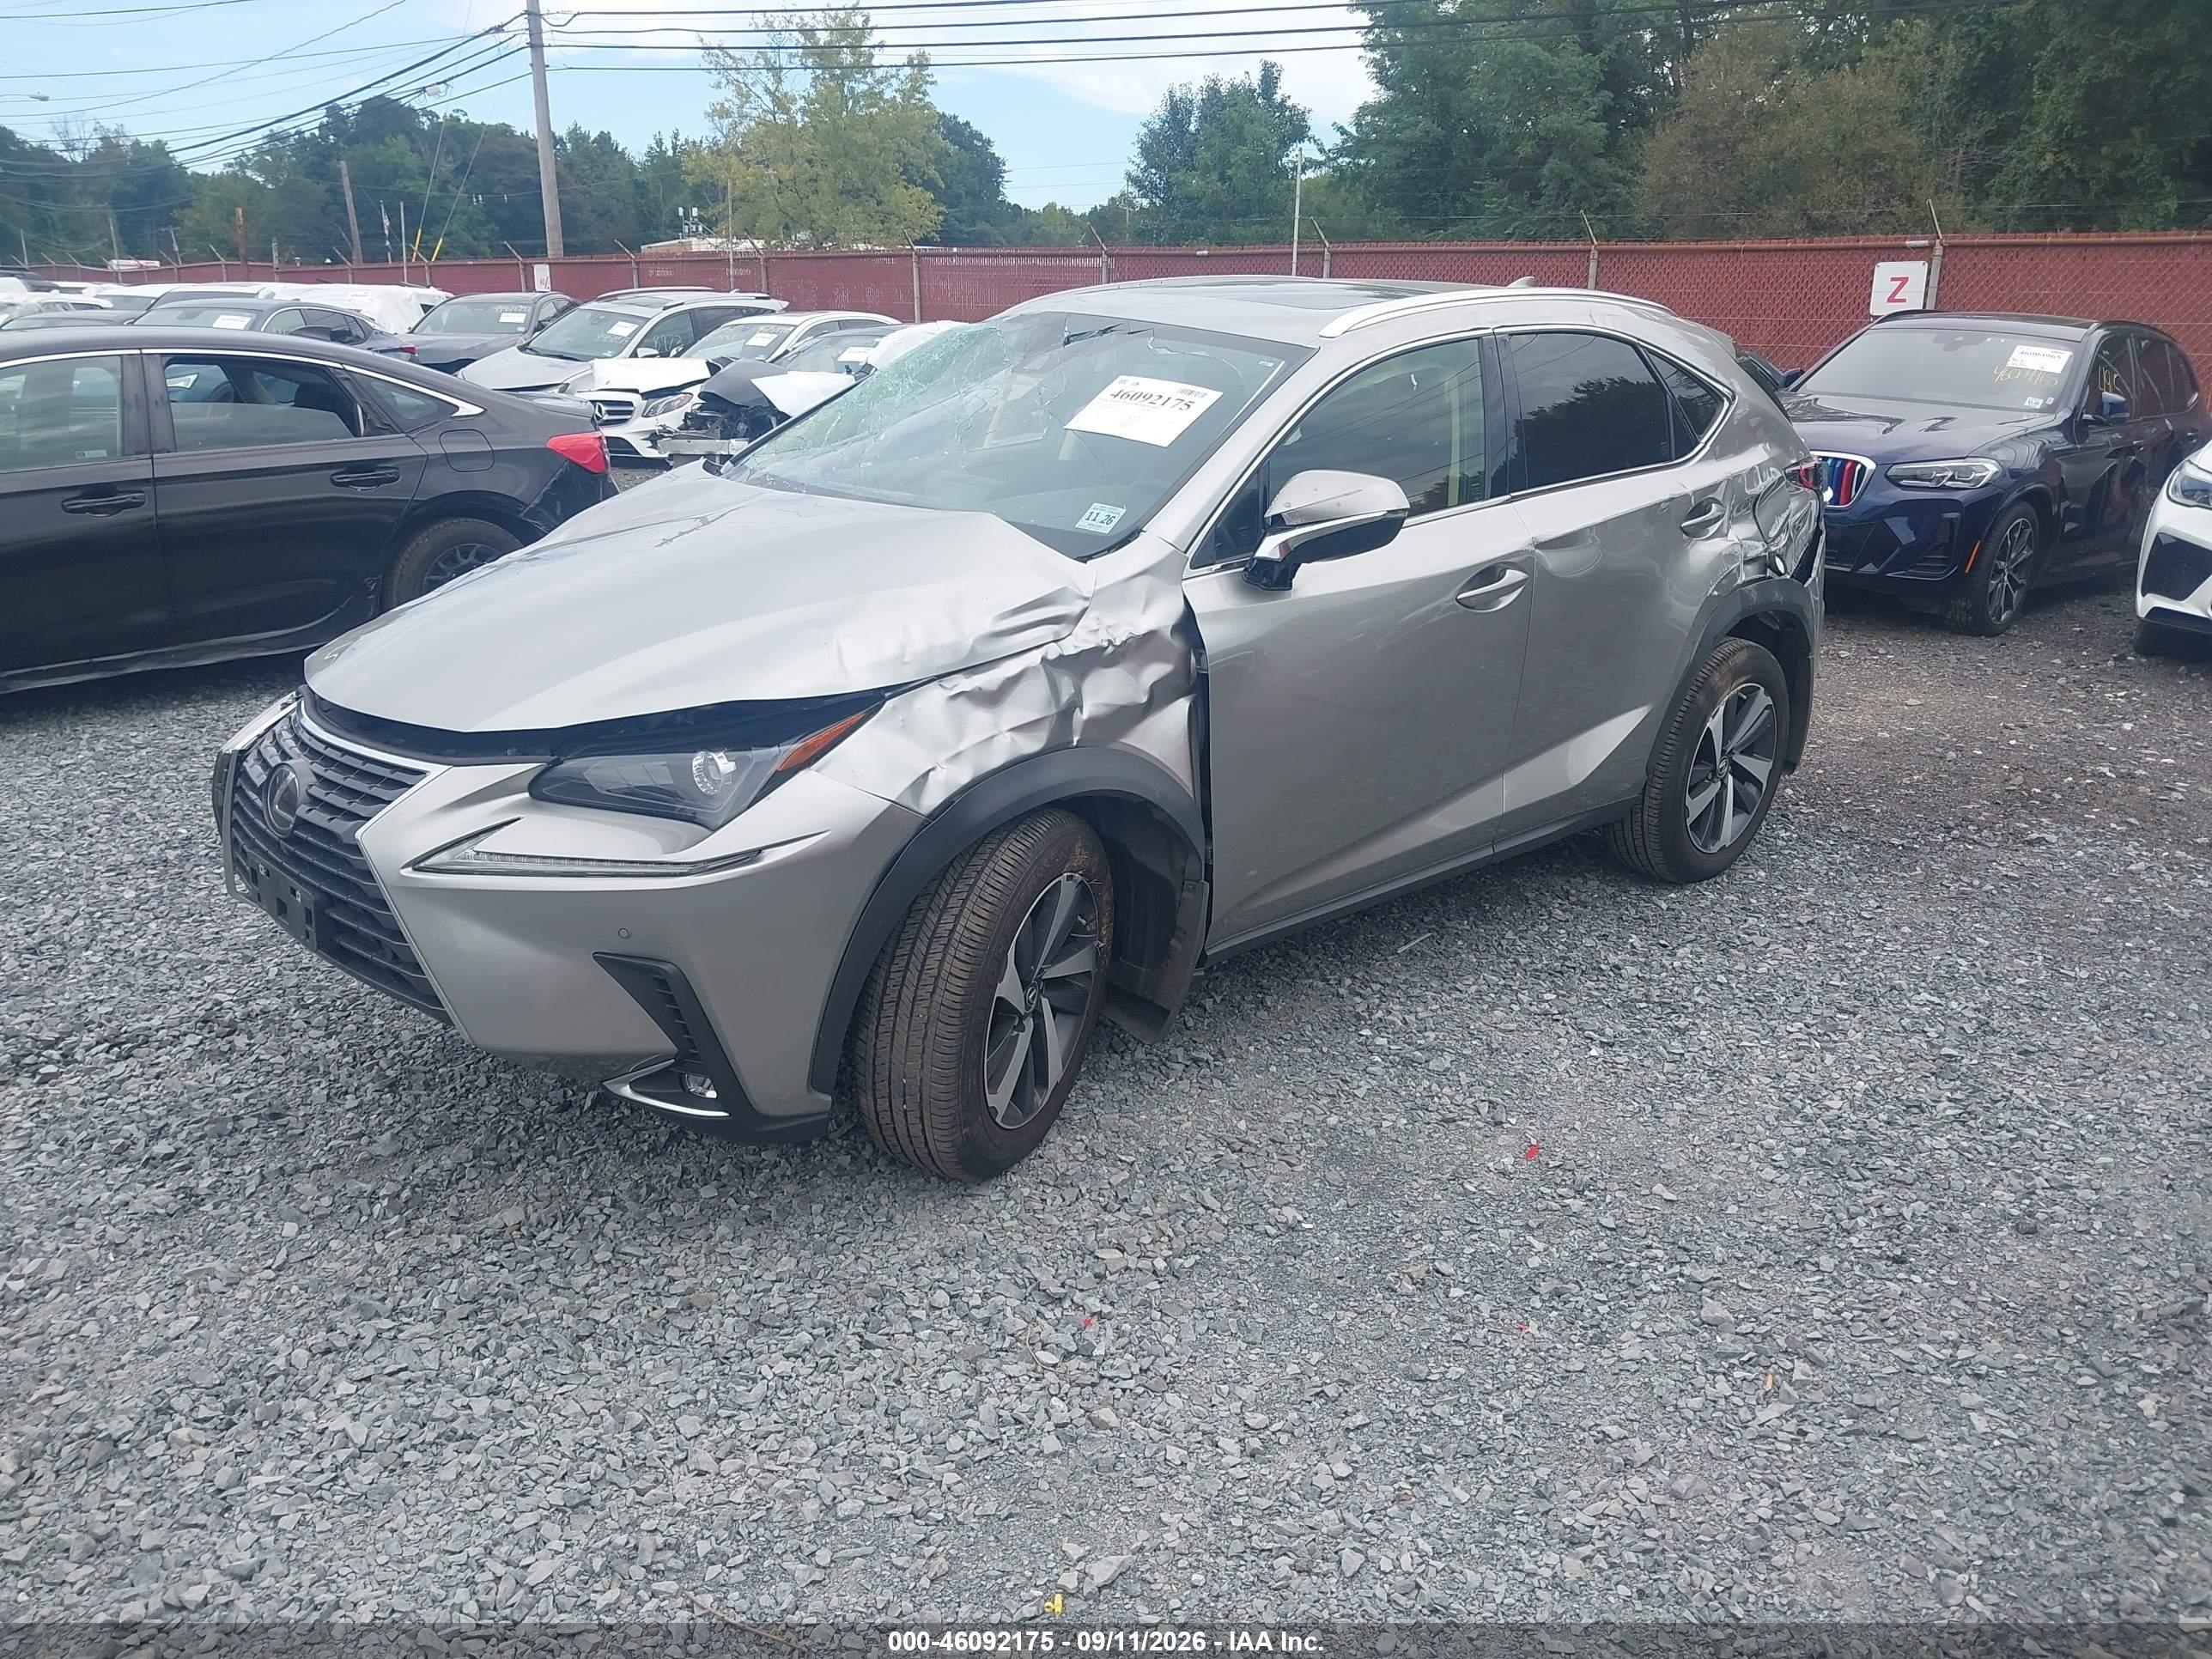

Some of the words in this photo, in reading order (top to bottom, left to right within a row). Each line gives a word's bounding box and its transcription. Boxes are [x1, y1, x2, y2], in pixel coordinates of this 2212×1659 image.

[1887, 276, 1909, 303] Z
[1110, 389, 1195, 411] 46092175
[1099, 514, 1116, 526] 26
